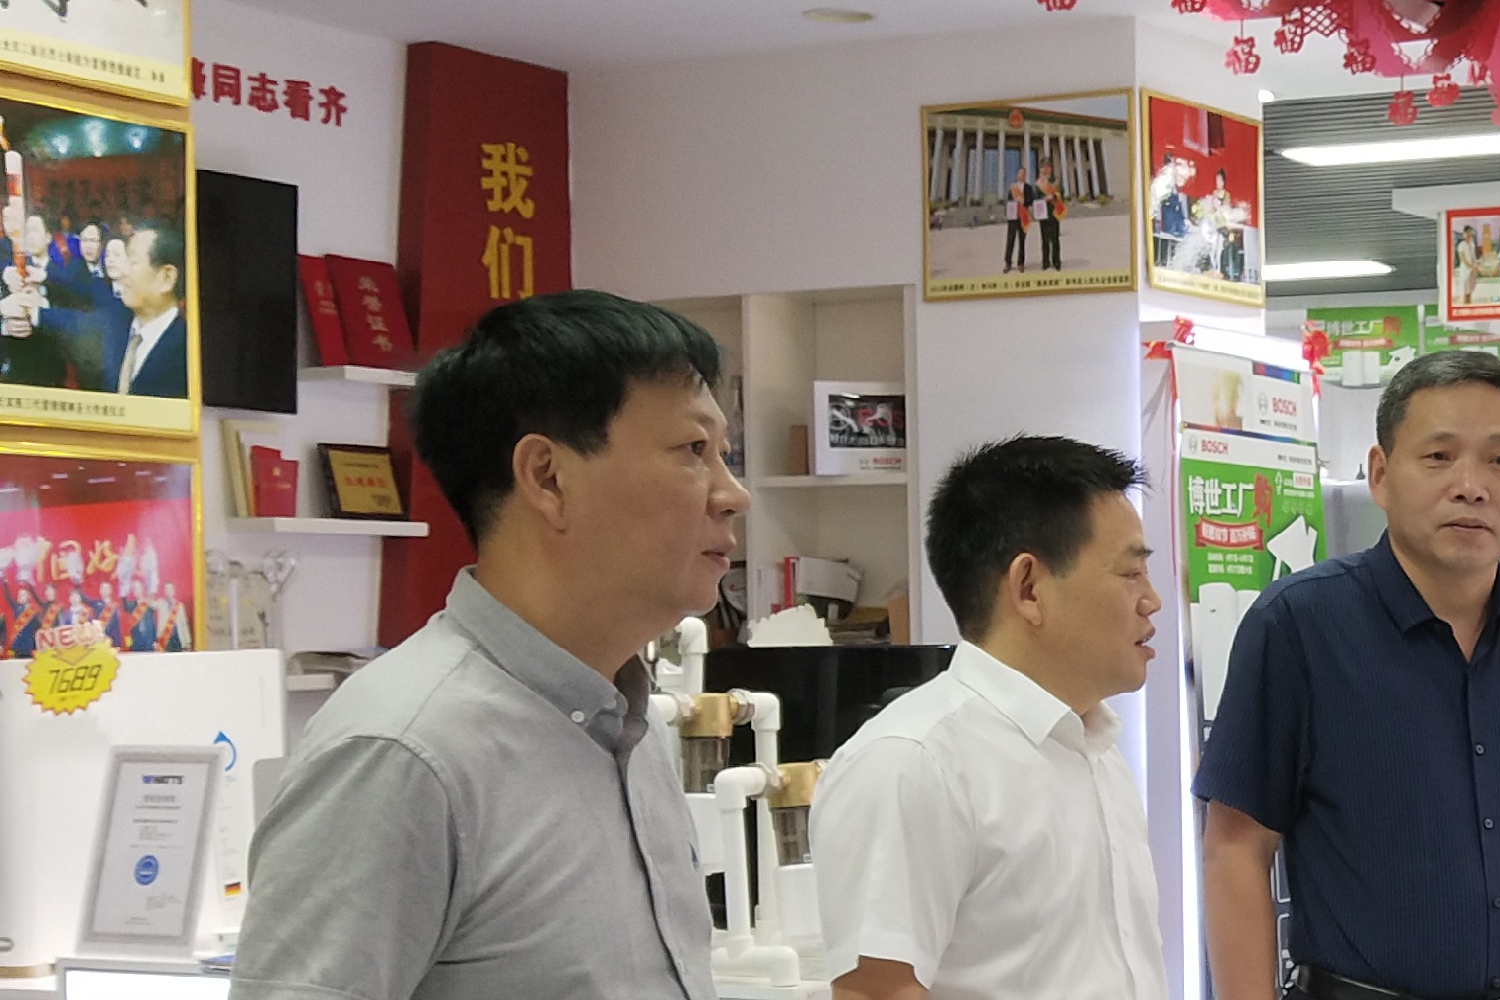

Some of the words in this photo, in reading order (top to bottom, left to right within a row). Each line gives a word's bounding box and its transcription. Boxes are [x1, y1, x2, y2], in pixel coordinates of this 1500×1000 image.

[481, 142, 535, 299] 我们
[1273, 397, 1297, 417] BOSCH
[1201, 439, 1229, 455] BOSCH
